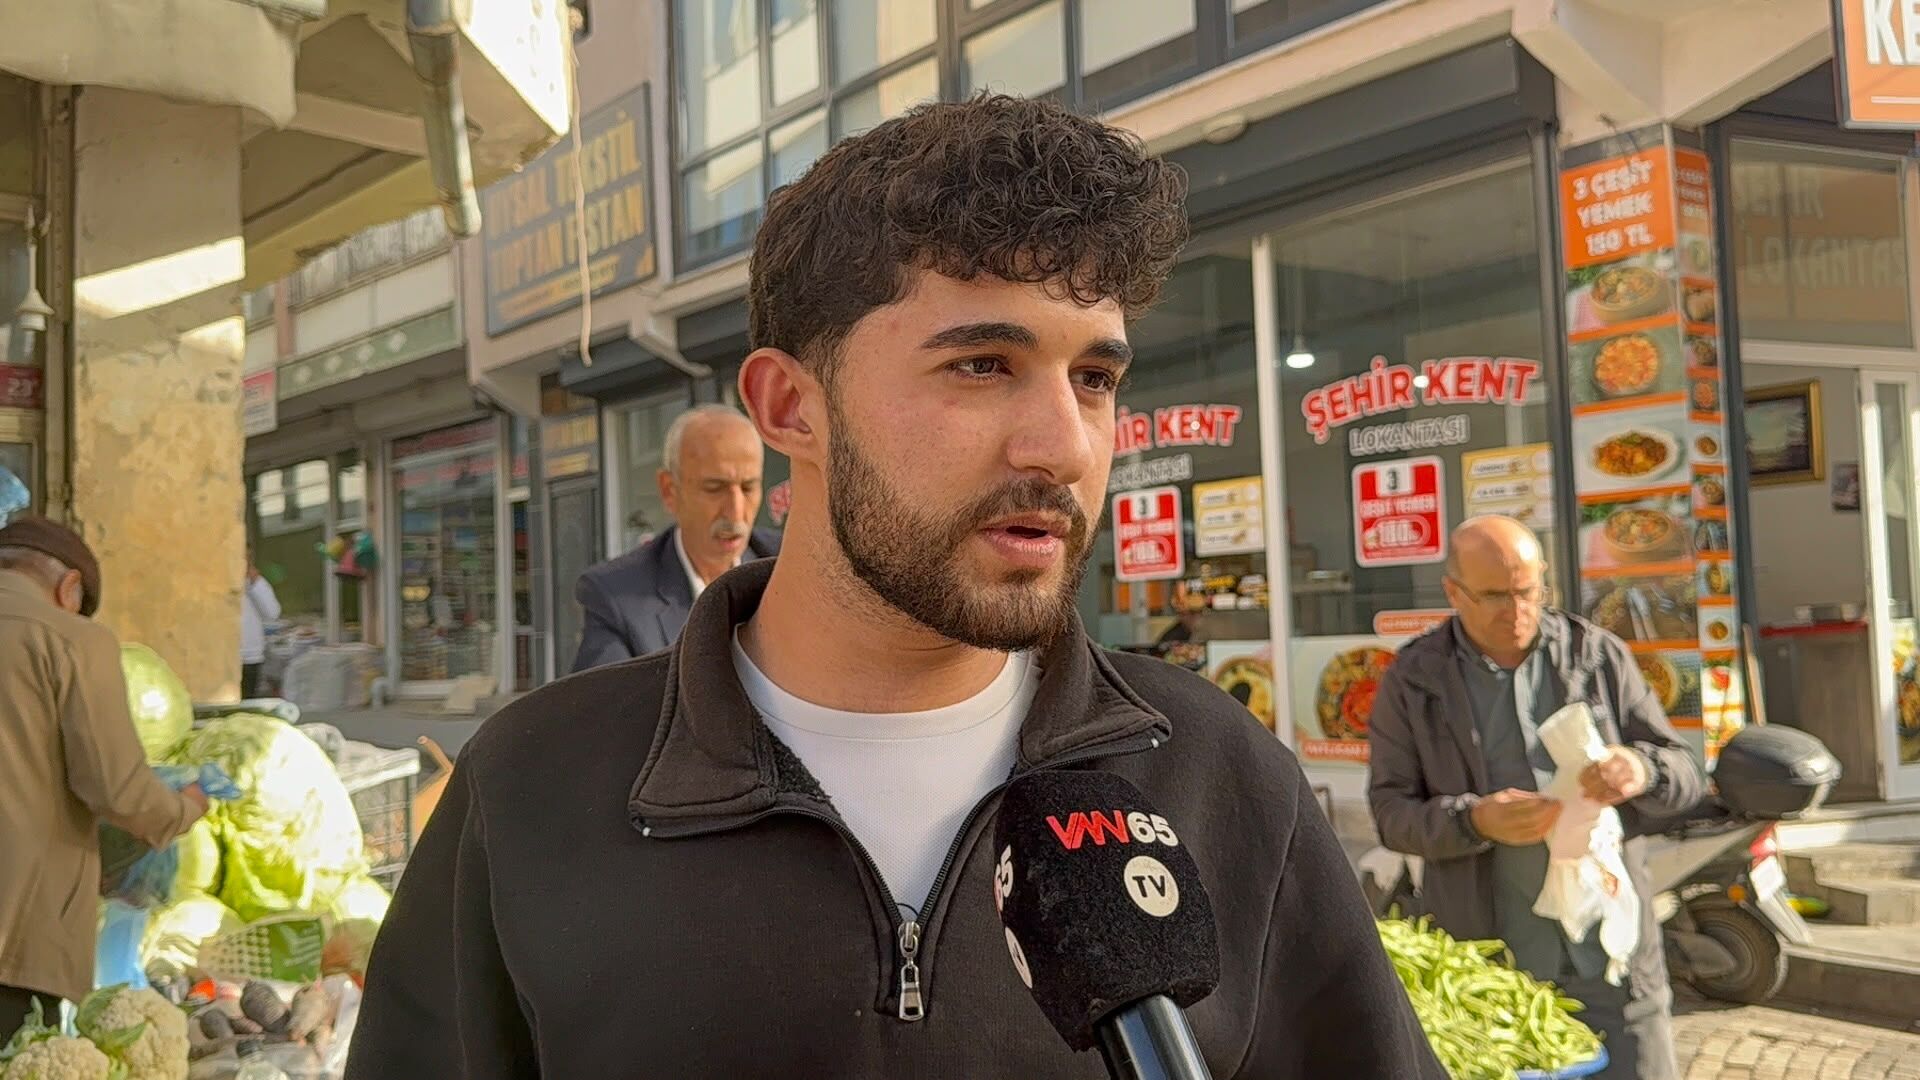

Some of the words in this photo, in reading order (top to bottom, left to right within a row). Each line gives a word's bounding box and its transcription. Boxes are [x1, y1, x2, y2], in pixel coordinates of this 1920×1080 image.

[1573, 177, 1589, 201] 3
[1577, 190, 1653, 229] YEMEK
[1624, 220, 1655, 248] TL
[1303, 356, 1417, 443] ŞEHİR
[1421, 357, 1543, 405] KENT
[1154, 404, 1242, 448] KENT
[1350, 414, 1471, 456] LOKANTASI
[1386, 467, 1400, 491] 3
[1132, 875, 1166, 898] TV
